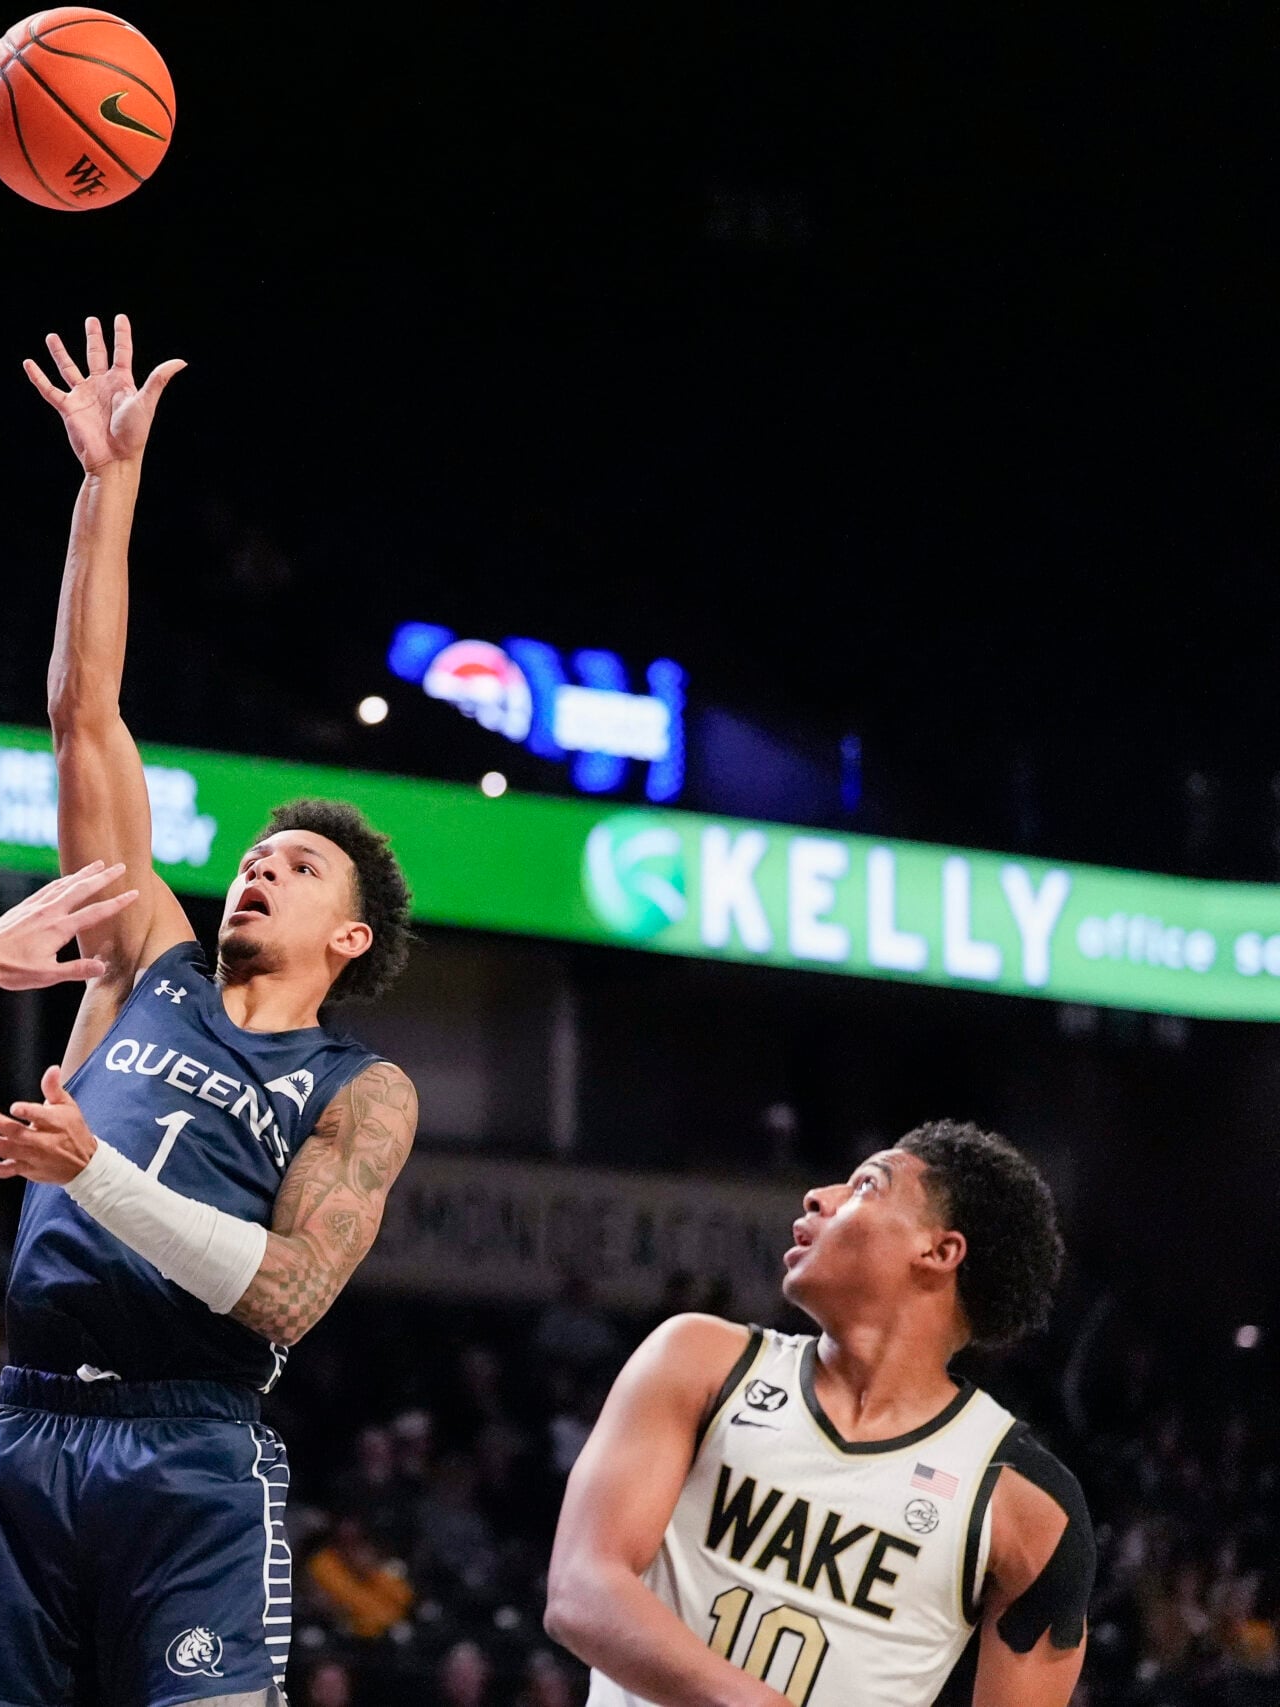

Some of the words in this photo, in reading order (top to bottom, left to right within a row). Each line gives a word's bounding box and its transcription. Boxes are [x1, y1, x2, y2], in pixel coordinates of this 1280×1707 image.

[697, 825, 1073, 987] KELLY
[1076, 911, 1217, 974] office
[144, 1109, 196, 1183] 1
[746, 1380, 787, 1412] 54
[703, 1464, 922, 1622] WAKE
[707, 1585, 830, 1707] 10
